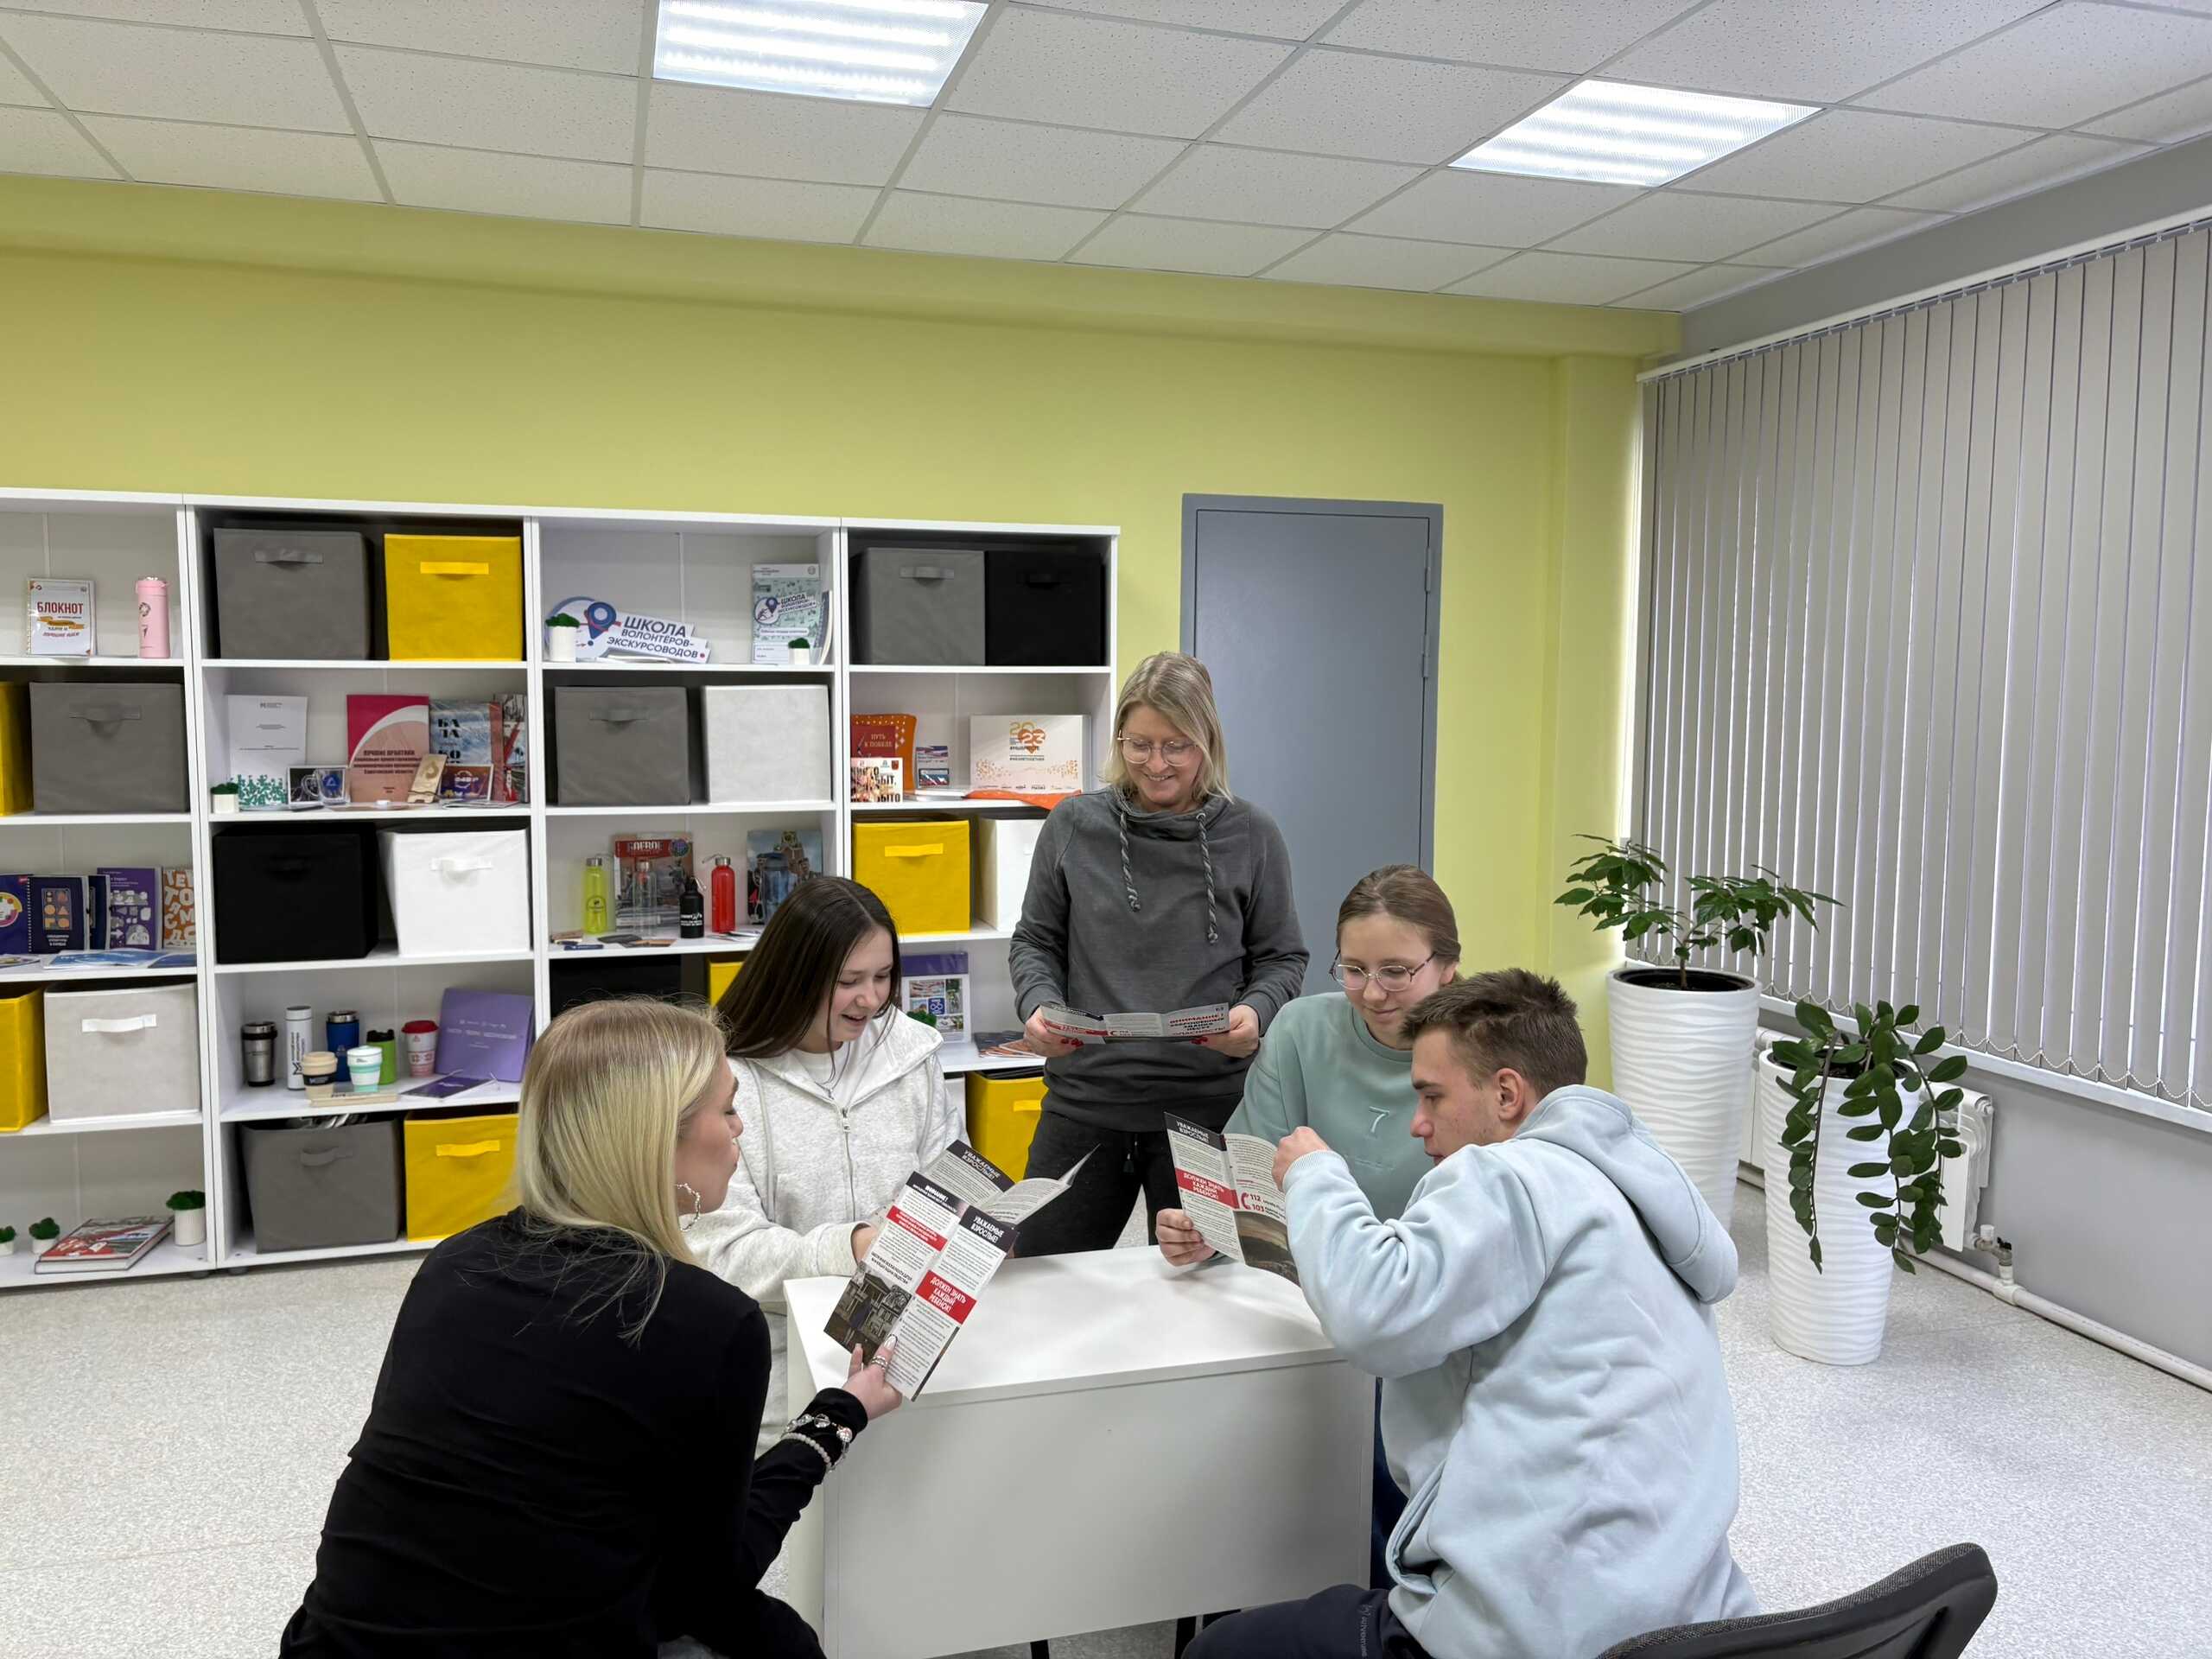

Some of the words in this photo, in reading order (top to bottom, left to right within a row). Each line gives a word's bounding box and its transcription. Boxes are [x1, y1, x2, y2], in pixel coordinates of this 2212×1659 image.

[36, 601, 84, 614] БЛОКНОТ
[623, 616, 687, 638] ШКОЛА
[606, 636, 698, 658] ЭКСКУРСОВОДОВ
[620, 628, 695, 648] ВОЛОНТЁРОВ-
[1021, 733, 1045, 746] 23
[1369, 1106, 1389, 1133] 7
[970, 1223, 1000, 1243] ВЗРОСЛЫЕ!
[973, 1216, 1005, 1238] УВАЖАЕМЫЕ
[930, 1276, 952, 1294] ДОЛЖЕН
[949, 1287, 968, 1304] ЗНАТЬ
[933, 1288, 956, 1306] КАЖДЫЙ
